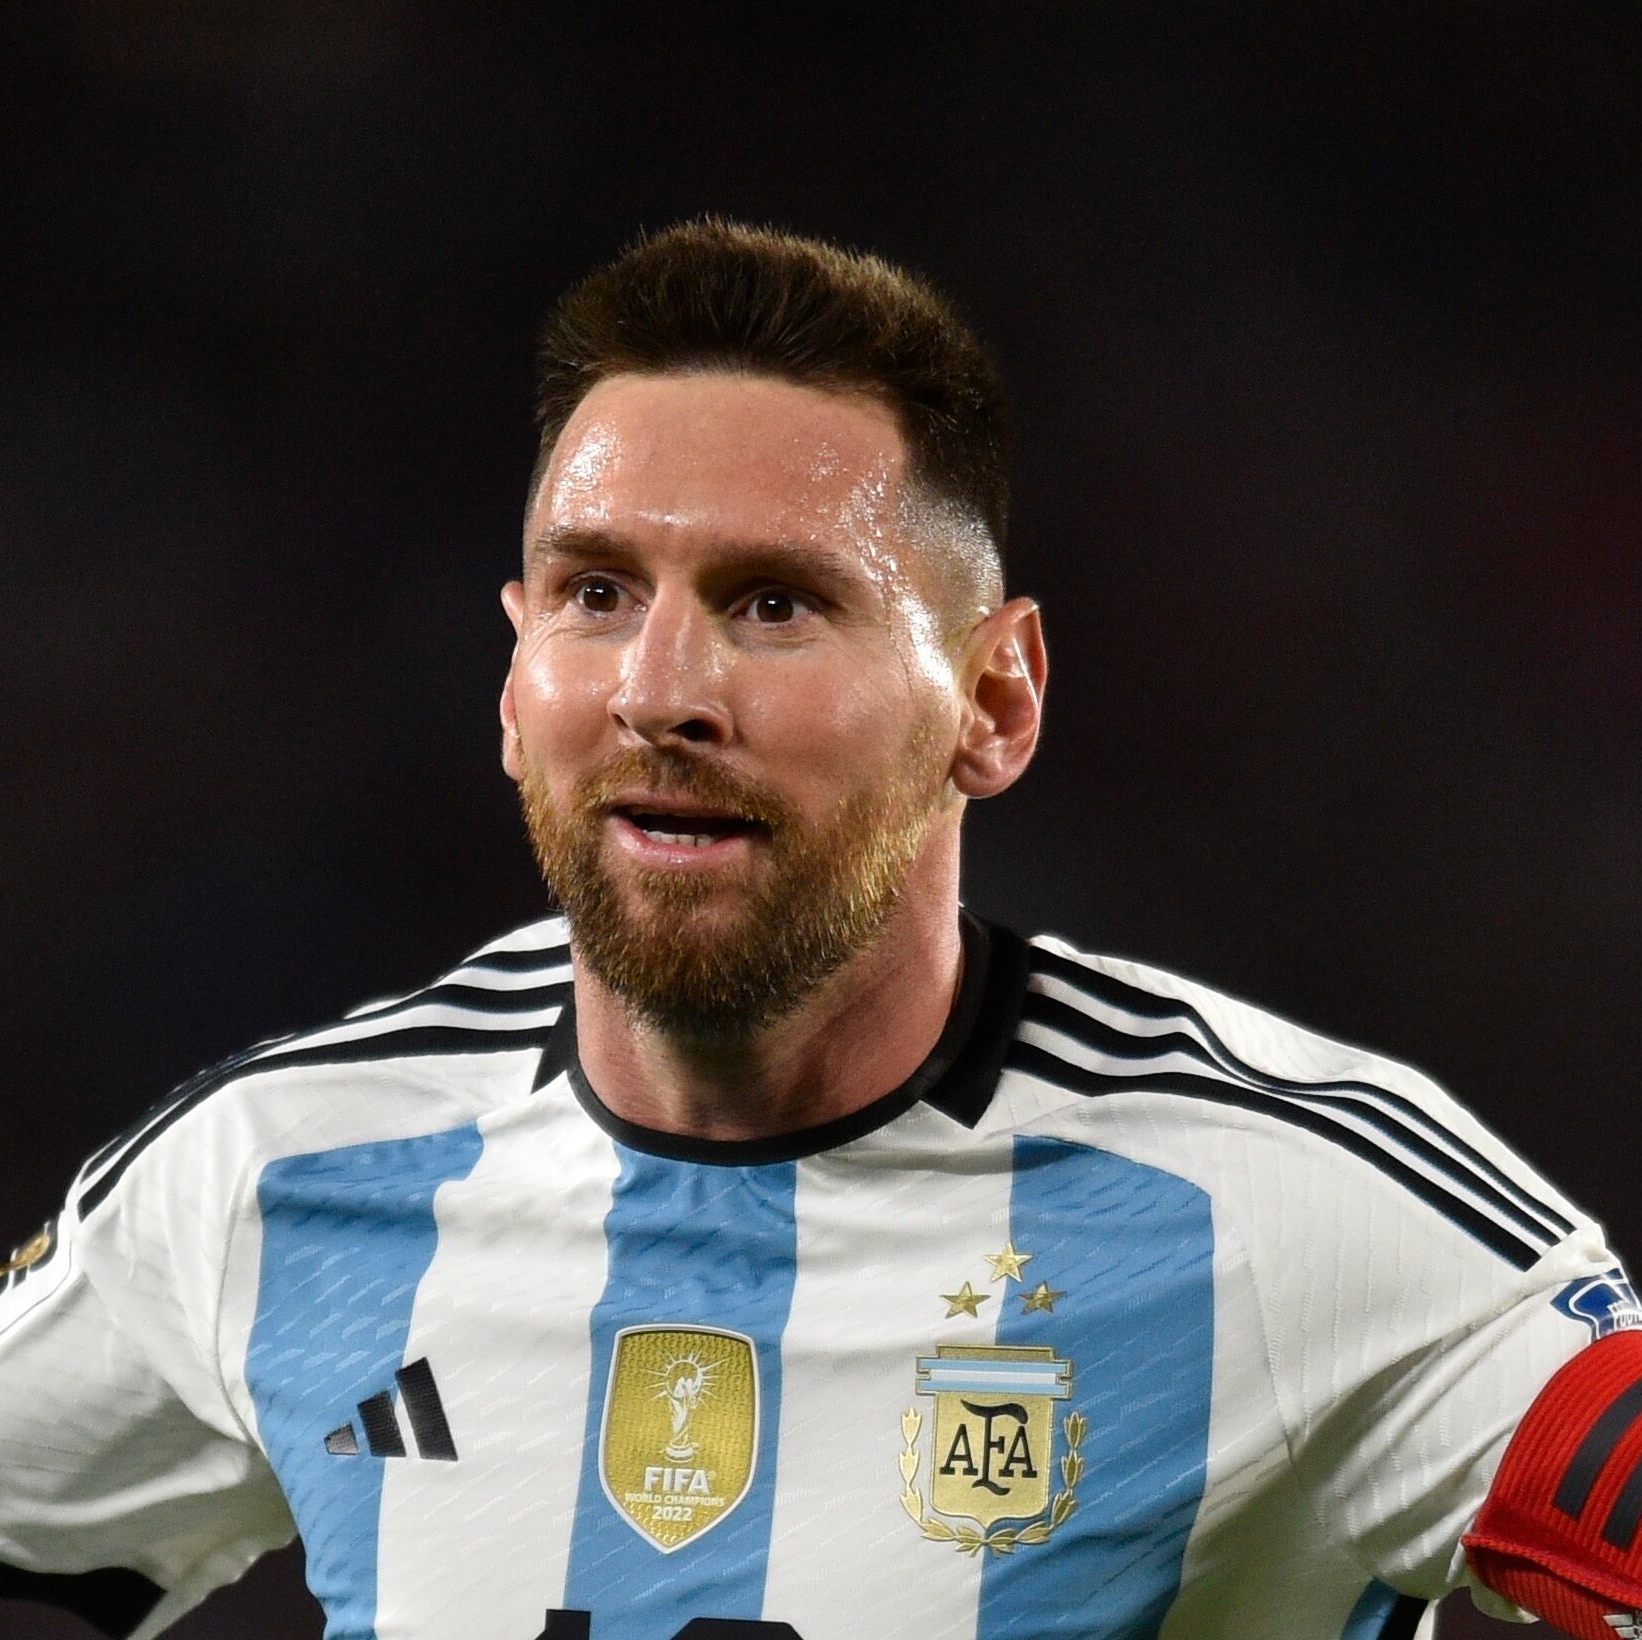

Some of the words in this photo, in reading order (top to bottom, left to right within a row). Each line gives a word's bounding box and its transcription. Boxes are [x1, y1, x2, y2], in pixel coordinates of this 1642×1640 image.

[938, 1398, 1038, 1496] AFA
[644, 1466, 710, 1495] FIFA
[624, 1491, 662, 1504] WORLD
[664, 1493, 726, 1507] CHAMPIONS
[651, 1505, 693, 1522] 2022
